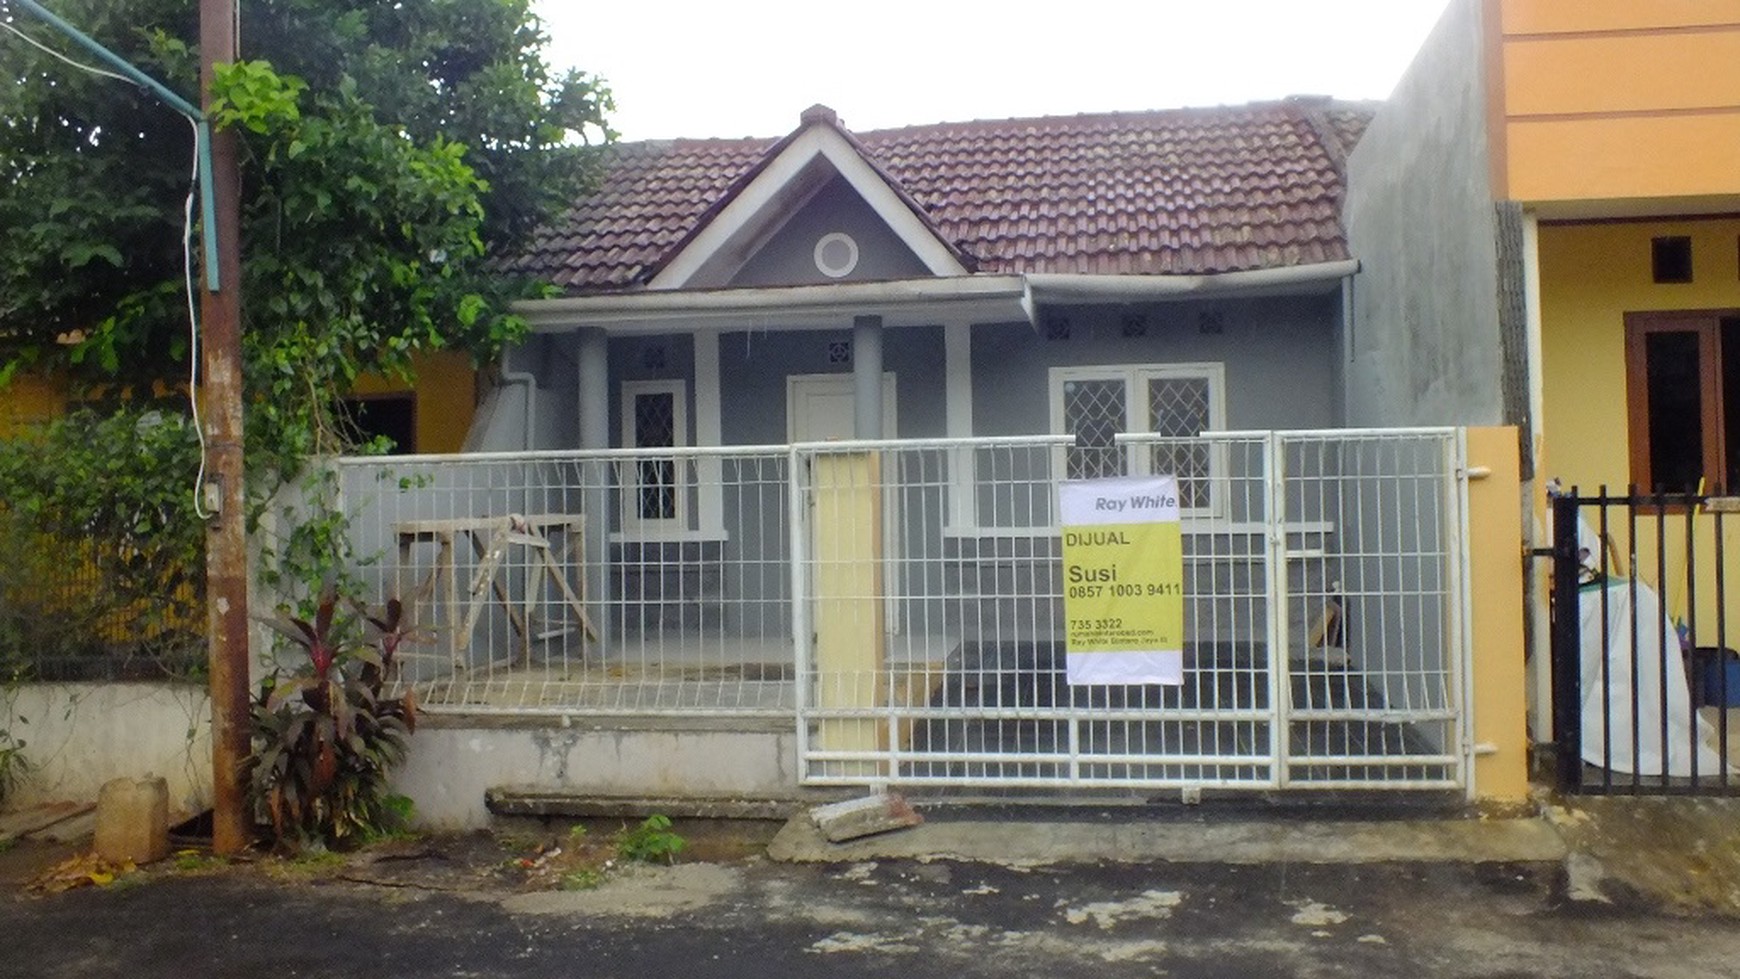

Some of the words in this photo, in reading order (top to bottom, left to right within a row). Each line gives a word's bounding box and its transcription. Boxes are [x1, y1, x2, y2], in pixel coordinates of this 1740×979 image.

[1095, 497, 1126, 512] Ray
[1131, 495, 1176, 510] White
[1066, 532, 1130, 547] DIJUAL
[1069, 564, 1117, 583] Susi
[1069, 586, 1102, 599] 0857
[1109, 584, 1142, 597] 1003
[1147, 583, 1180, 596] 9411
[1071, 620, 1092, 630] 735
[1096, 618, 1122, 630] 3322
